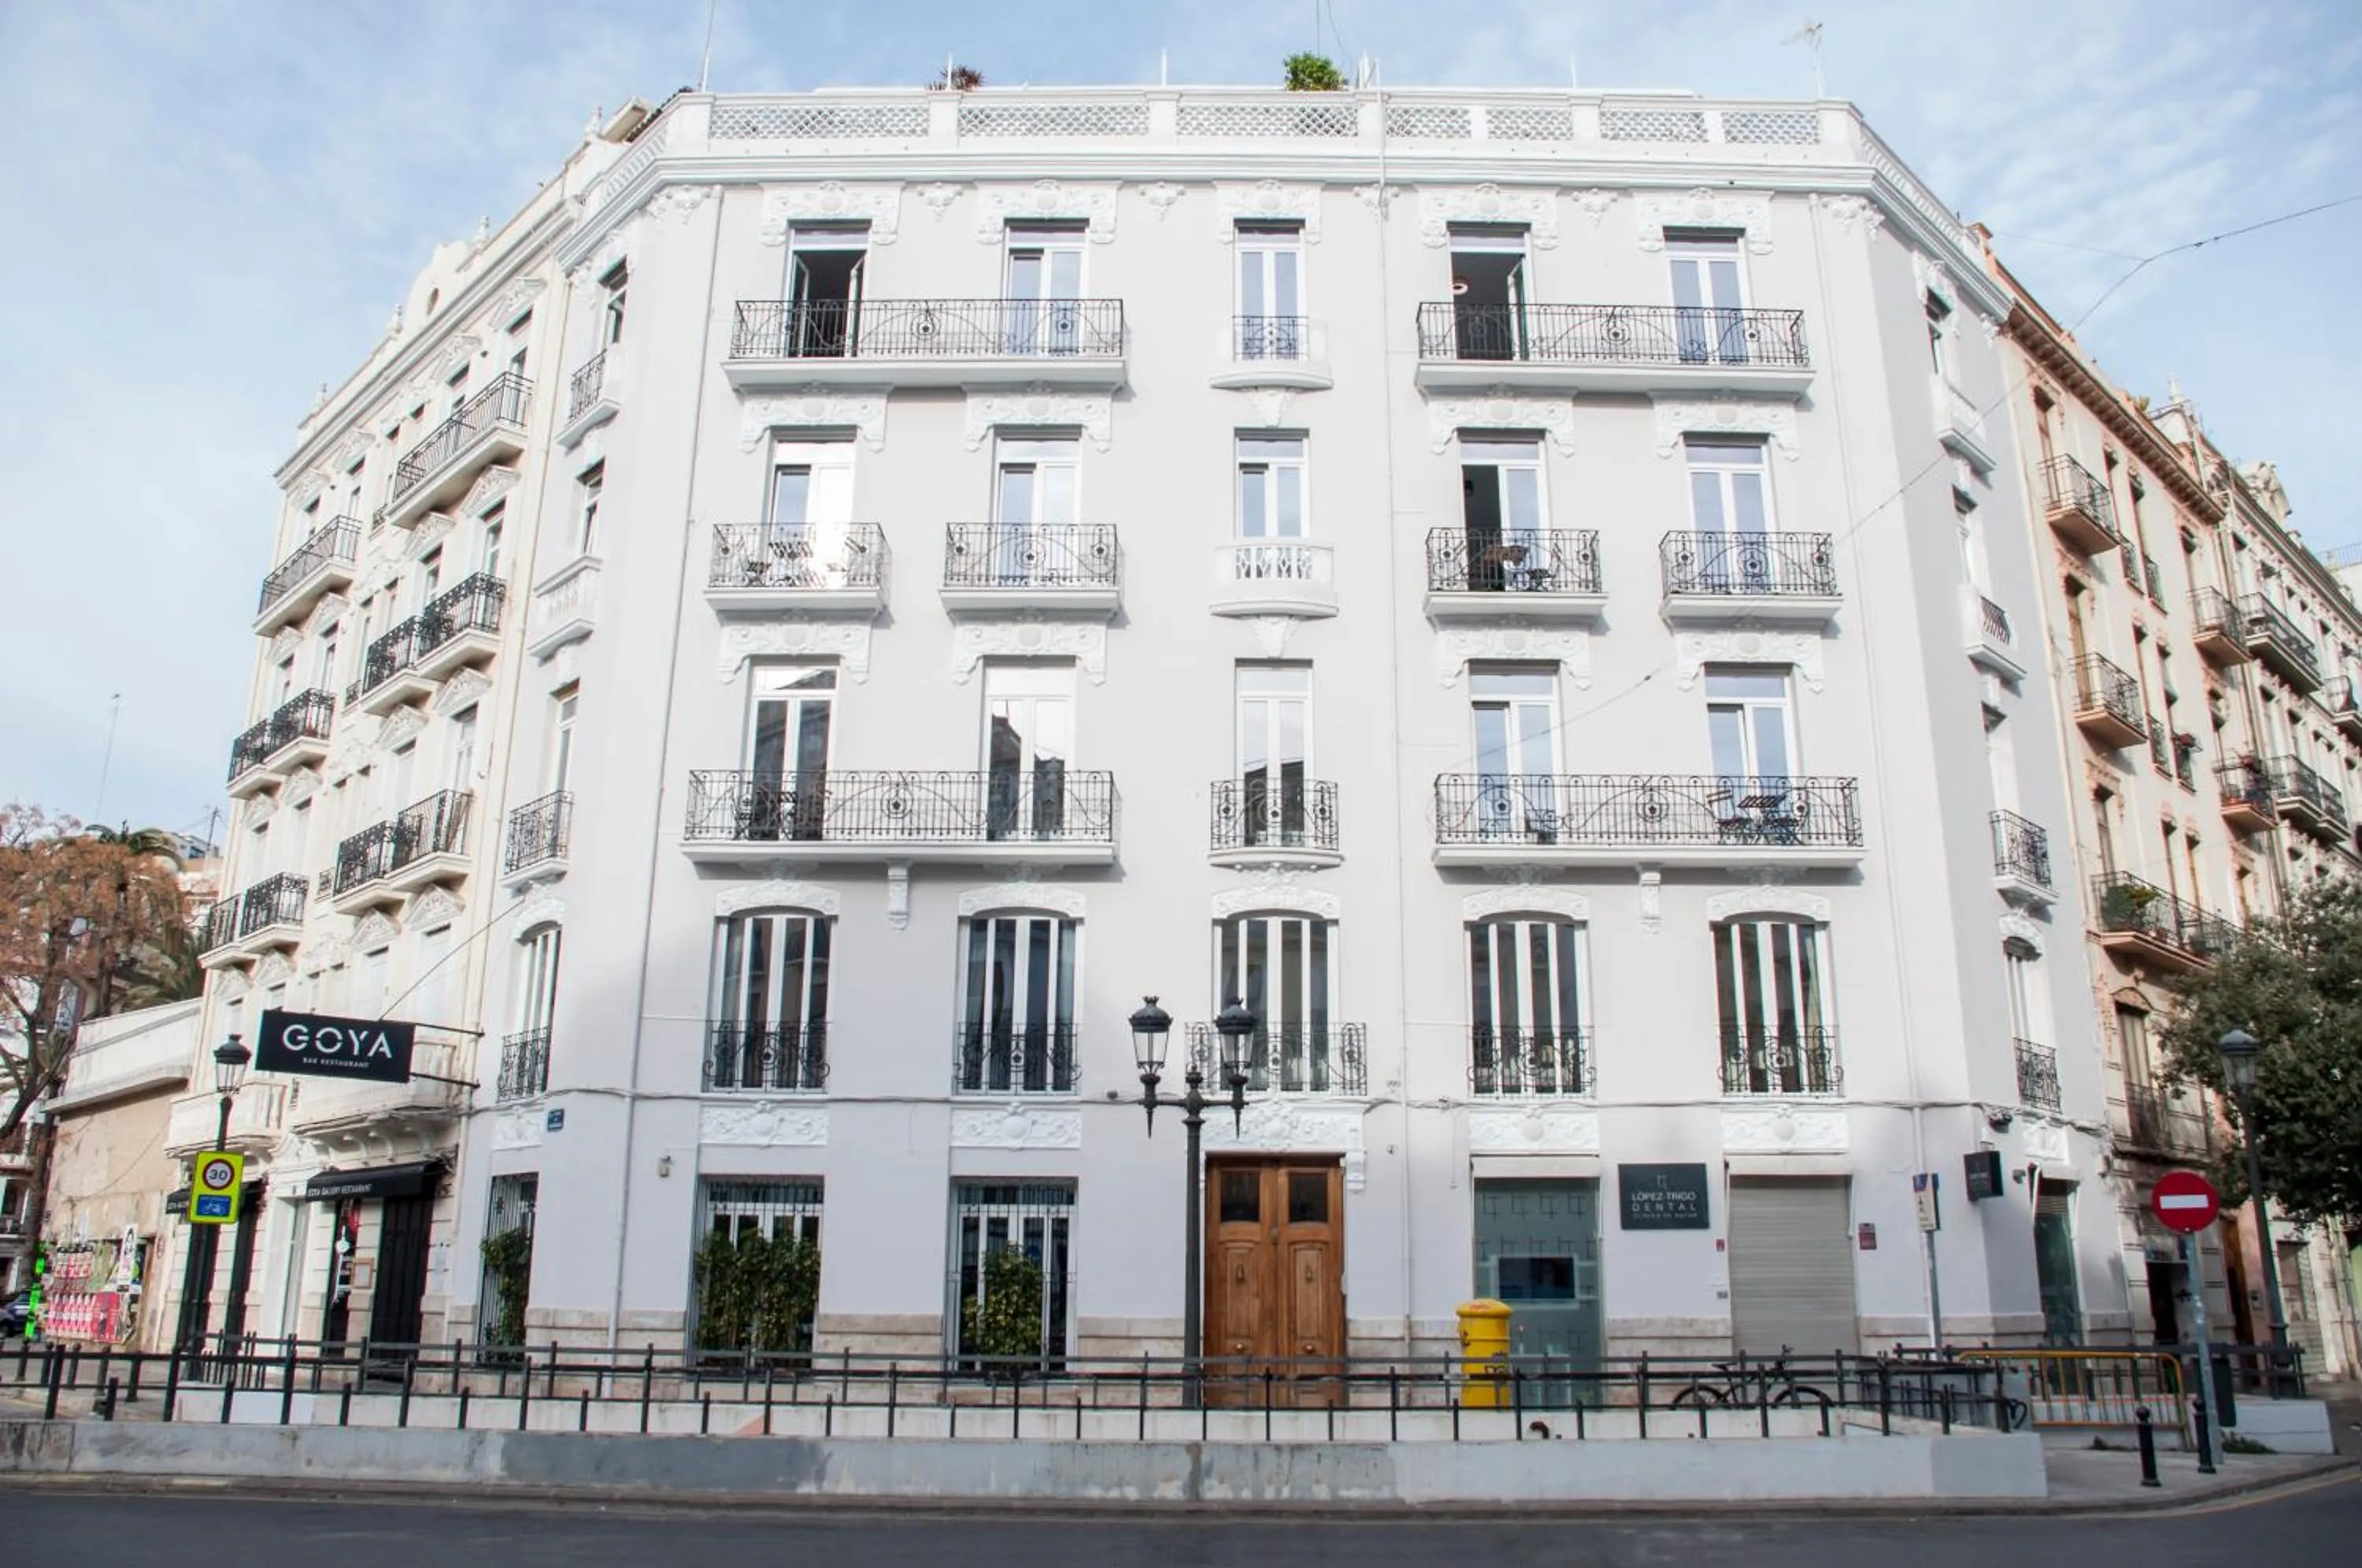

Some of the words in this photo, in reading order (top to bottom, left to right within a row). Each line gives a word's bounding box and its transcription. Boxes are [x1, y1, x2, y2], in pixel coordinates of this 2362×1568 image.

[283, 1024, 392, 1059] GOYA
[320, 1058, 369, 1068] RESTAURANT
[209, 1169, 228, 1180] 30
[1631, 1202, 1696, 1211] DENTAL
